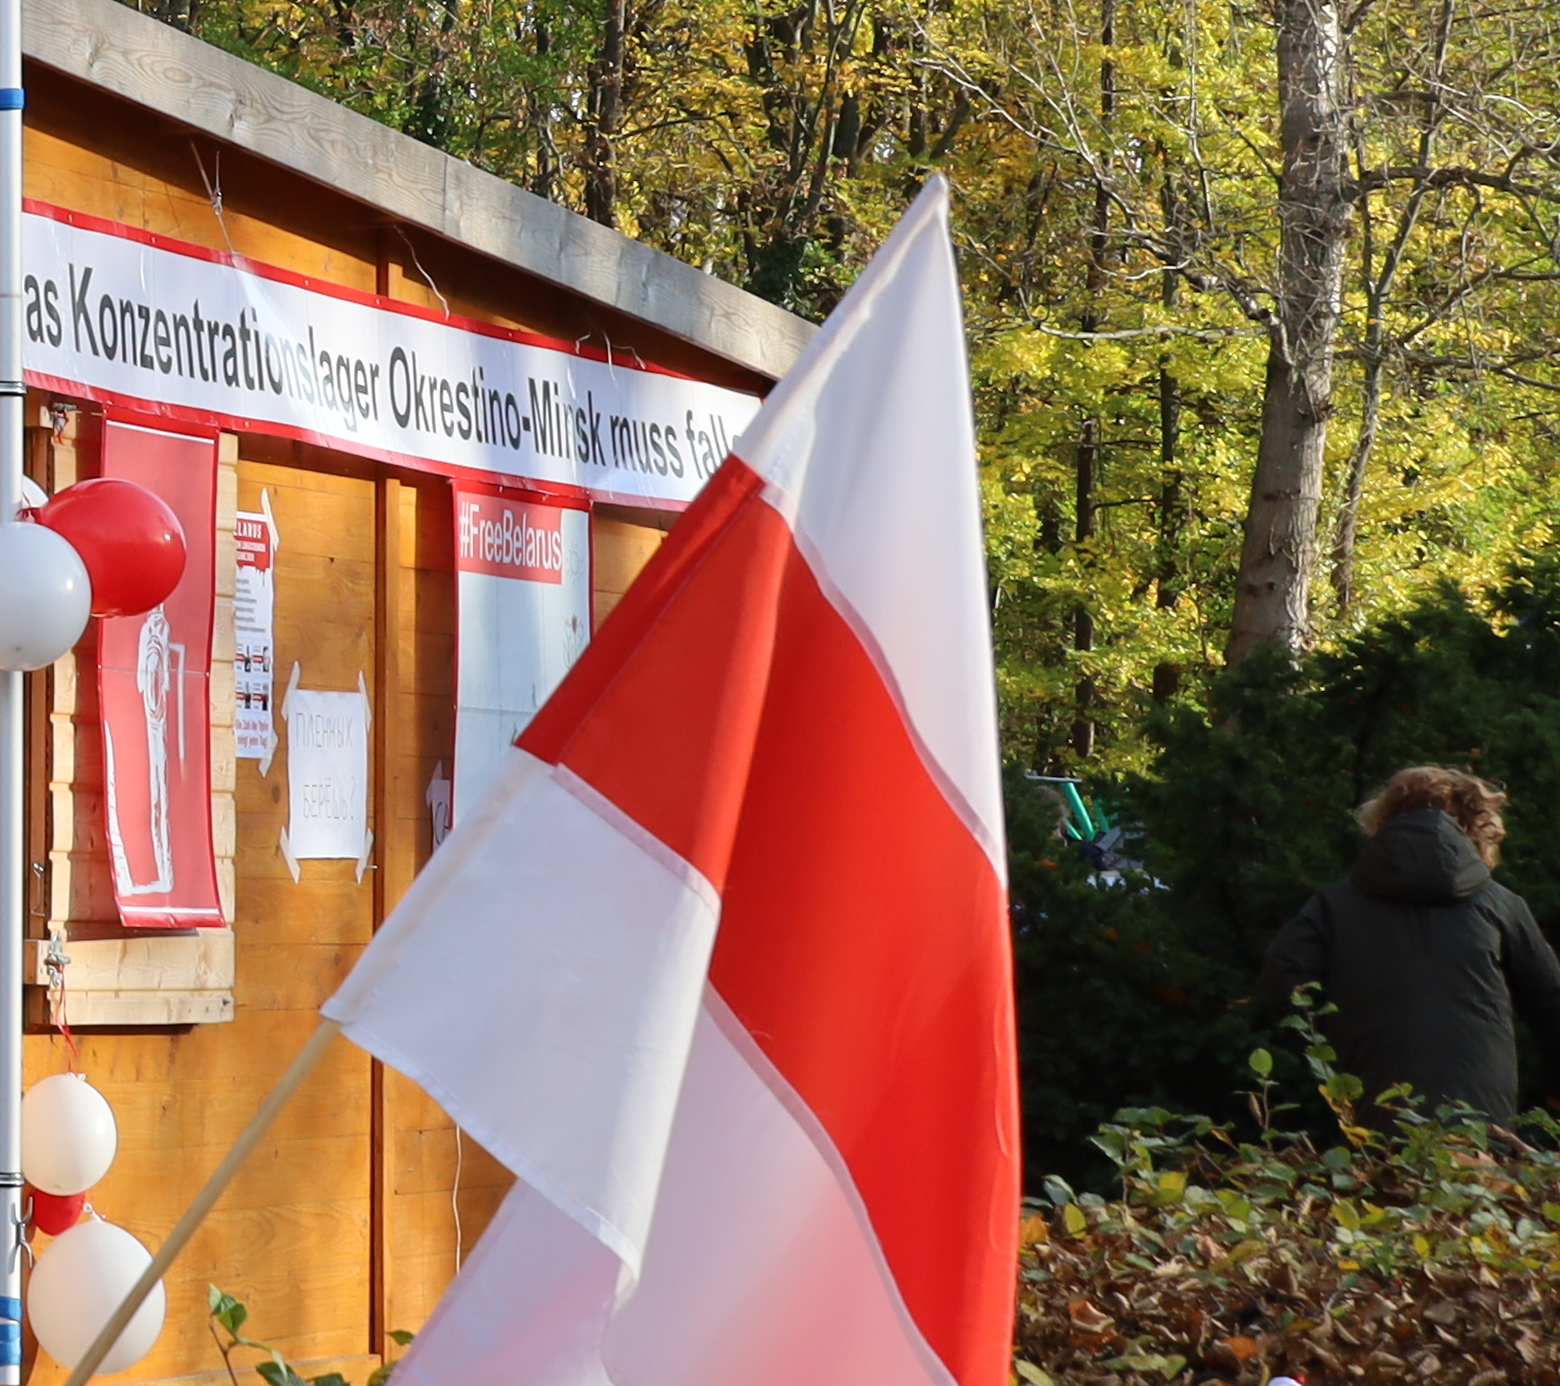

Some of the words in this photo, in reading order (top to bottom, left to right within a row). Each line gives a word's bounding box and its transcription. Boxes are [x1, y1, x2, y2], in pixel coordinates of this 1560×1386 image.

[23, 273, 63, 349] as
[69, 262, 380, 433] Konzentrationslager
[389, 346, 606, 466] Okrestino-Minsk
[610, 410, 684, 480] muss
[686, 409, 741, 480] fall
[233, 521, 262, 539] LARUS
[459, 501, 563, 571] #FreeBelarus
